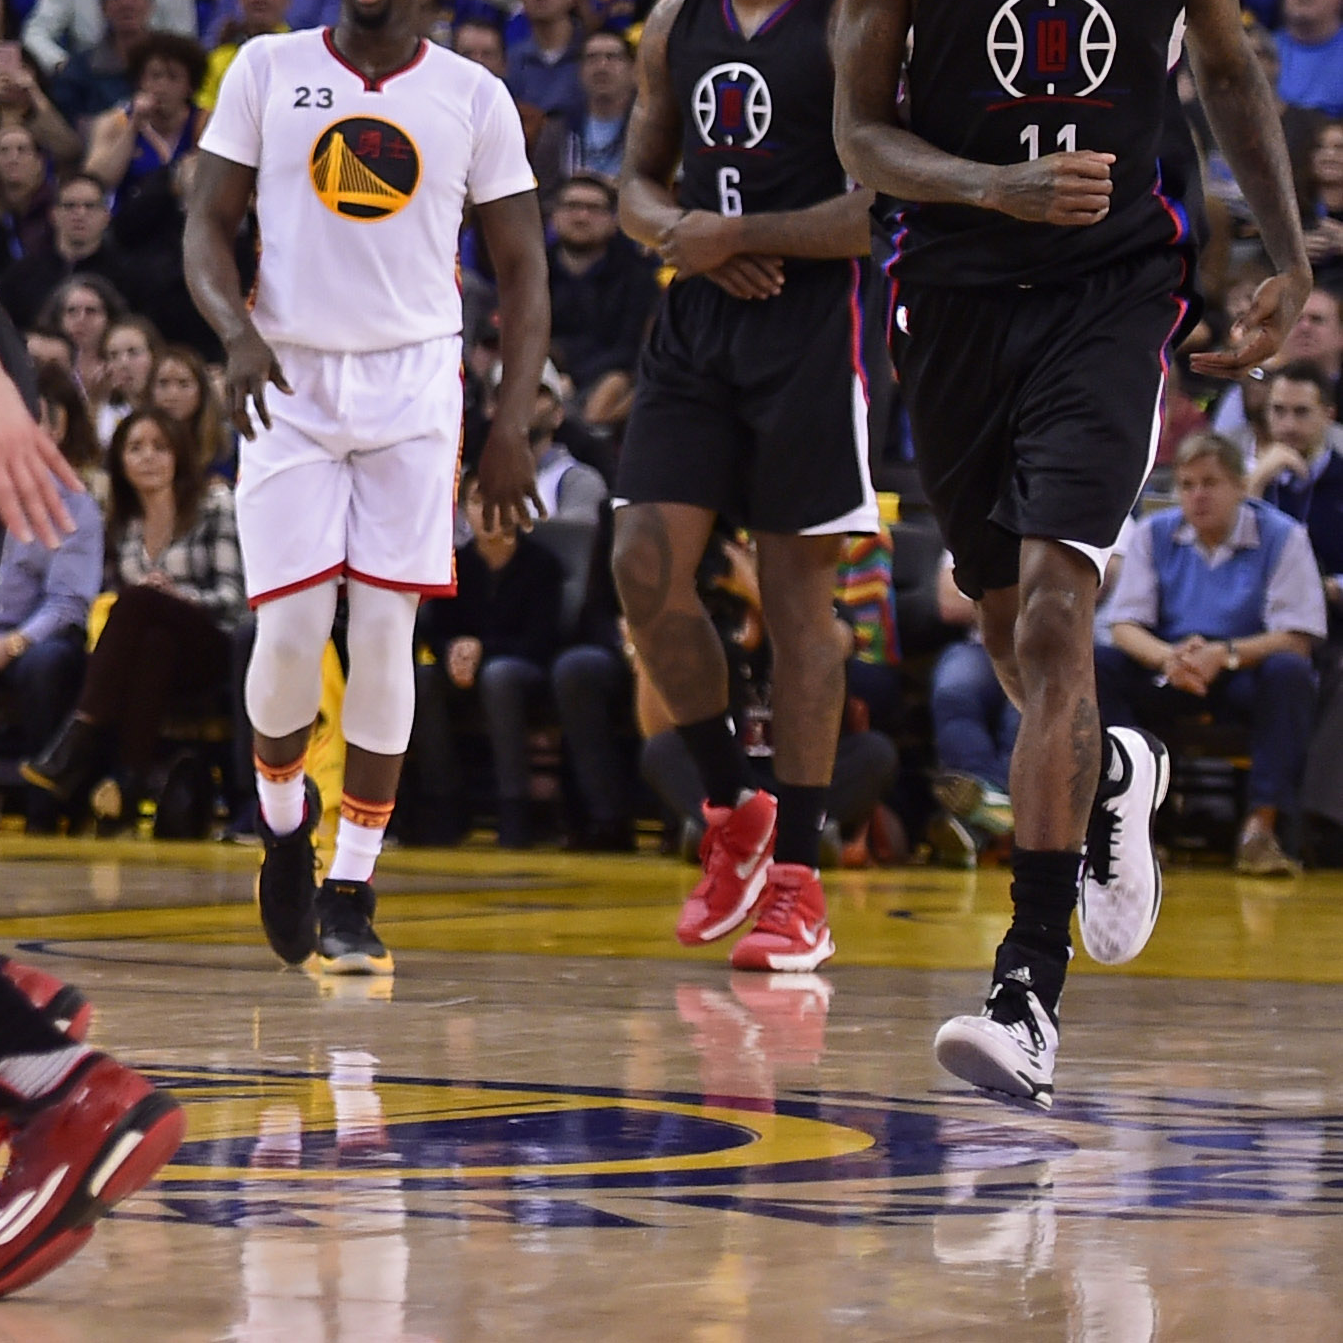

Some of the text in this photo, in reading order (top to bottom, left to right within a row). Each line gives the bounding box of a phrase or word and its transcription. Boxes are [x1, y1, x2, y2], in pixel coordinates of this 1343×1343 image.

[293, 86, 334, 109] 23
[1020, 124, 1077, 161] 11
[719, 166, 743, 218] 6
